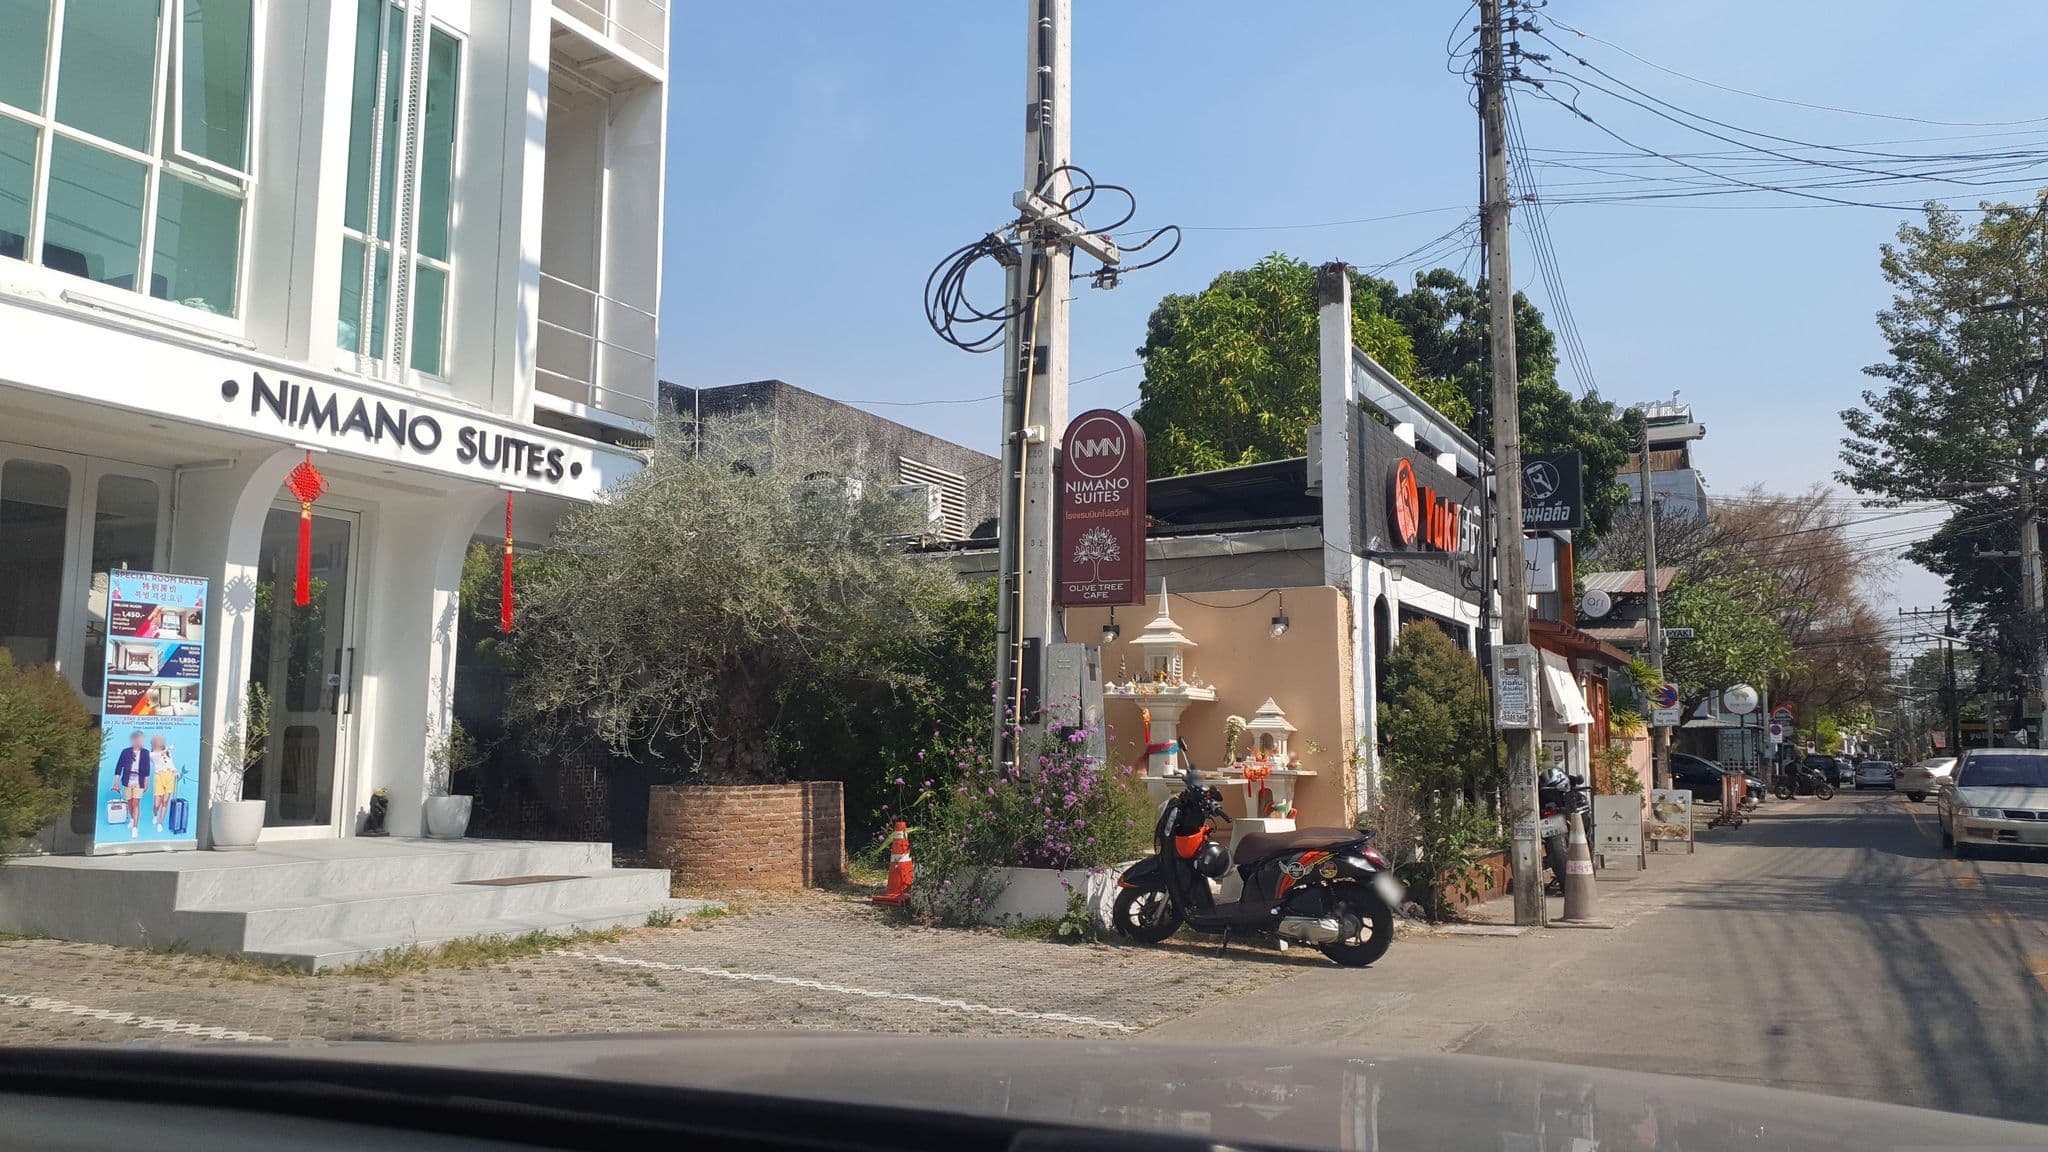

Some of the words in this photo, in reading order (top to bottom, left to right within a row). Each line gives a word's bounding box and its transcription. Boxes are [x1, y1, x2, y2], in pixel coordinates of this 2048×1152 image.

[251, 371, 442, 452] NIMANO
[457, 426, 565, 482] SUITES
[1065, 477, 1130, 494] NIMANO
[1074, 490, 1121, 504] SUITES
[1424, 485, 1458, 553] Yuki
[115, 571, 150, 582] SPECIAL
[152, 574, 177, 584] ROOM
[178, 577, 204, 586] RATES
[1098, 582, 1125, 591] TREE
[1083, 592, 1109, 600] CAFE
